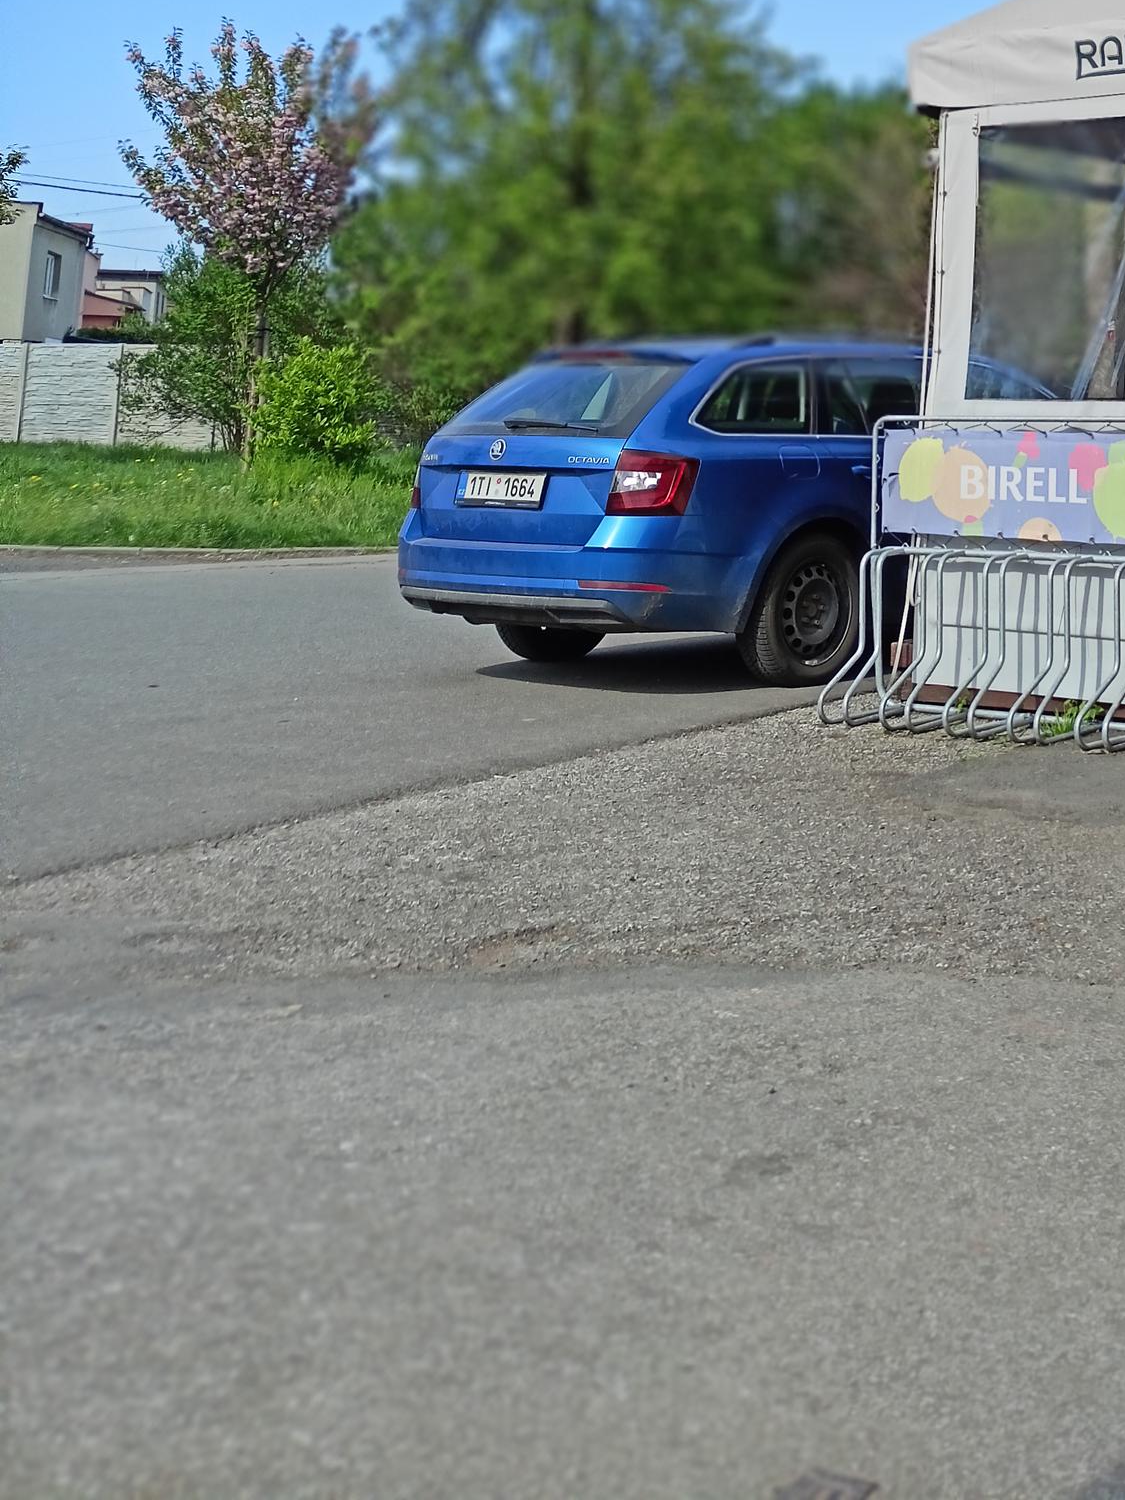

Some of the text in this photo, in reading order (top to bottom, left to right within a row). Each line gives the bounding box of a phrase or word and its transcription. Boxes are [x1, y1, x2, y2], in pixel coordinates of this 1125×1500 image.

[567, 456, 610, 465] OCTAVIA
[469, 476, 536, 498] 1TI 1664
[959, 464, 1088, 504] BIRELL
